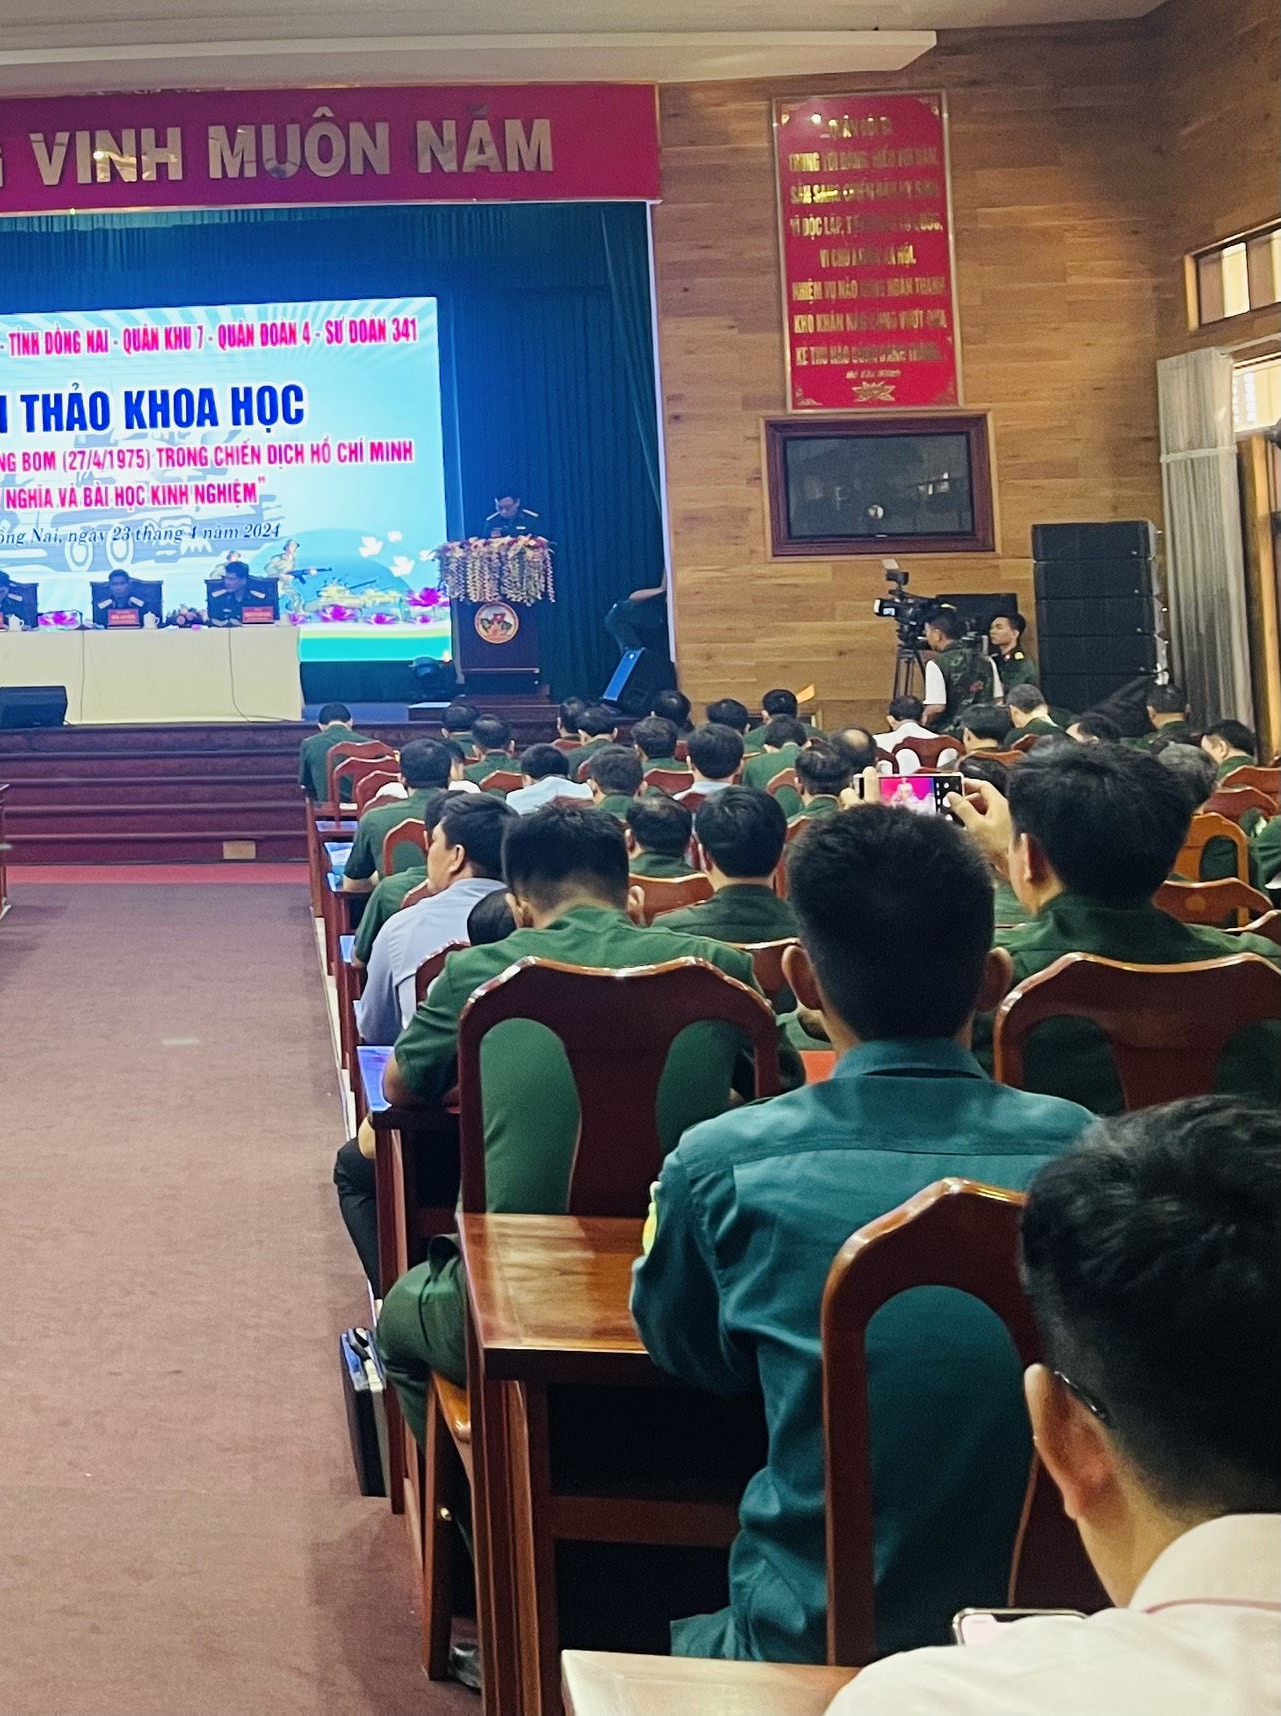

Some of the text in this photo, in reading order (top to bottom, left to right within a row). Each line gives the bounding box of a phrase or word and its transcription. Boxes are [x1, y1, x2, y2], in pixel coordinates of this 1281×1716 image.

[30, 127, 183, 187] VINH
[208, 108, 390, 179] MUÔN
[416, 104, 553, 174] NĂM
[86, 329, 109, 353] NAI
[123, 324, 159, 354] QUÂN
[165, 325, 192, 350] KHU
[196, 325, 204, 349] 7
[219, 320, 255, 350] QUÂN
[260, 317, 297, 346] ĐOÀN
[302, 321, 311, 345] 4
[392, 317, 417, 342] 341
[20, 382, 110, 433] THẢO
[124, 387, 219, 430] KHOA
[231, 384, 304, 433] HỌC
[22, 450, 56, 472] BOM
[62, 448, 151, 473] (27/4/1975)
[156, 445, 209, 469] TRONG
[214, 438, 261, 467] CHIẾN
[267, 443, 305, 469] DỊCH
[337, 438, 364, 463] CHÍ
[370, 440, 413, 463] MINH
[6, 484, 54, 509] NGHĨA
[58, 482, 78, 508] VÀ
[83, 482, 108, 508] BÀI
[115, 485, 145, 511] HỌC
[151, 484, 190, 506] KINH
[33, 528, 62, 544] Nai,
[113, 526, 131, 541] 23
[244, 523, 281, 538] 2024
